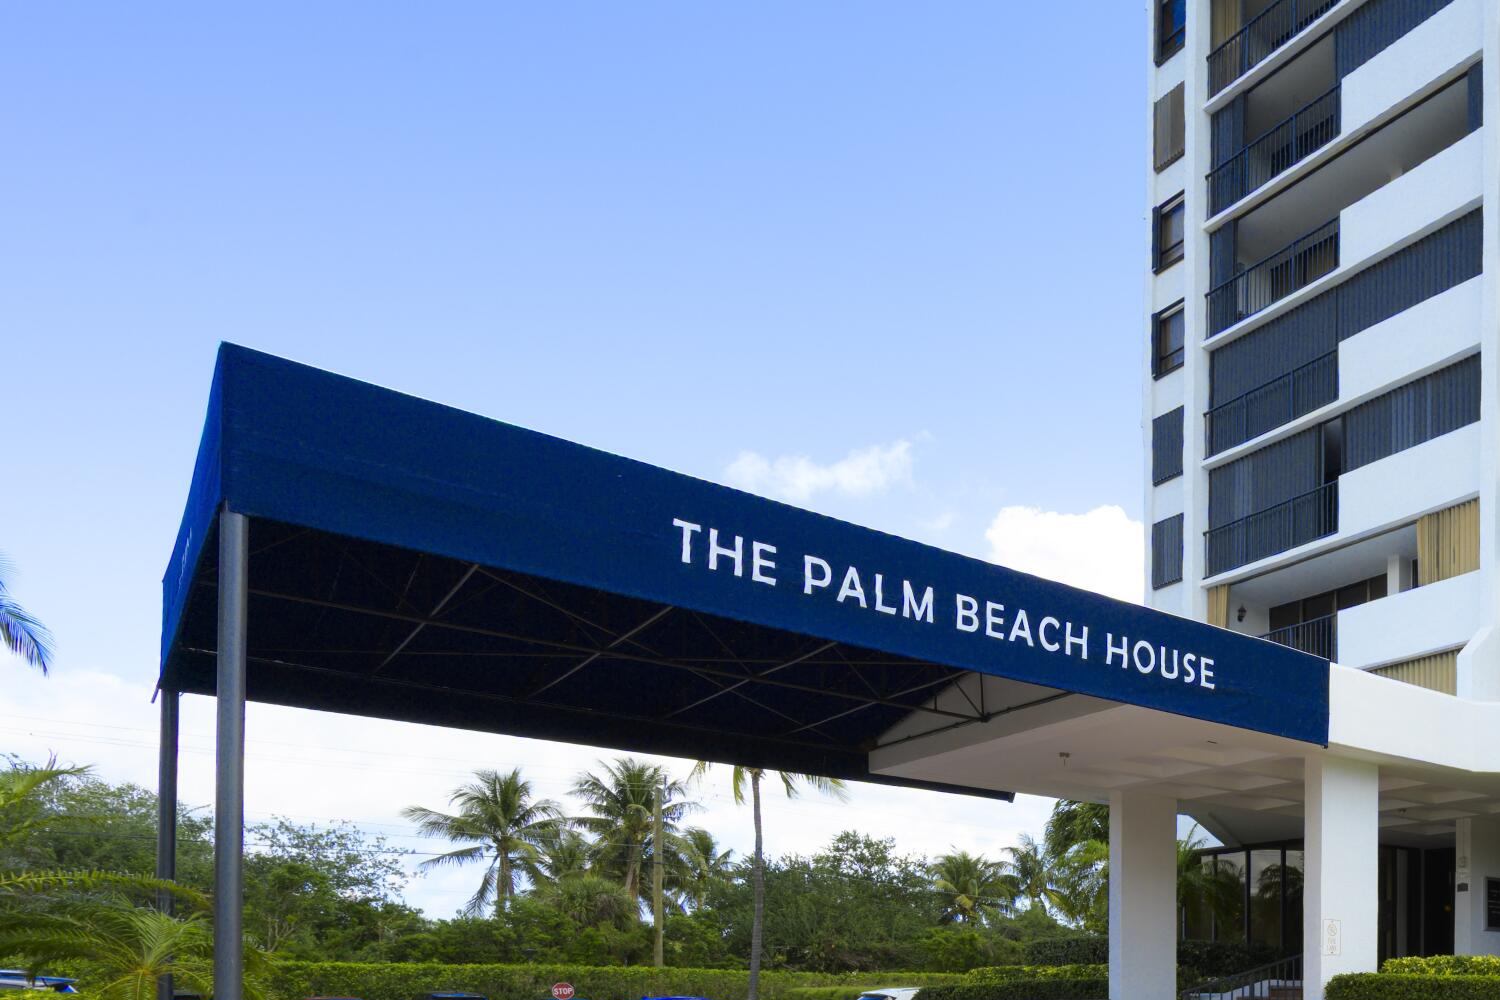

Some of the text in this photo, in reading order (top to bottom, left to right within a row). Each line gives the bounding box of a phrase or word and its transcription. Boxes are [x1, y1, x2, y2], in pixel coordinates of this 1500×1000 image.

[672, 518, 1216, 690] THE PALM BEACH HOUSE
[553, 987, 573, 996] STOP
